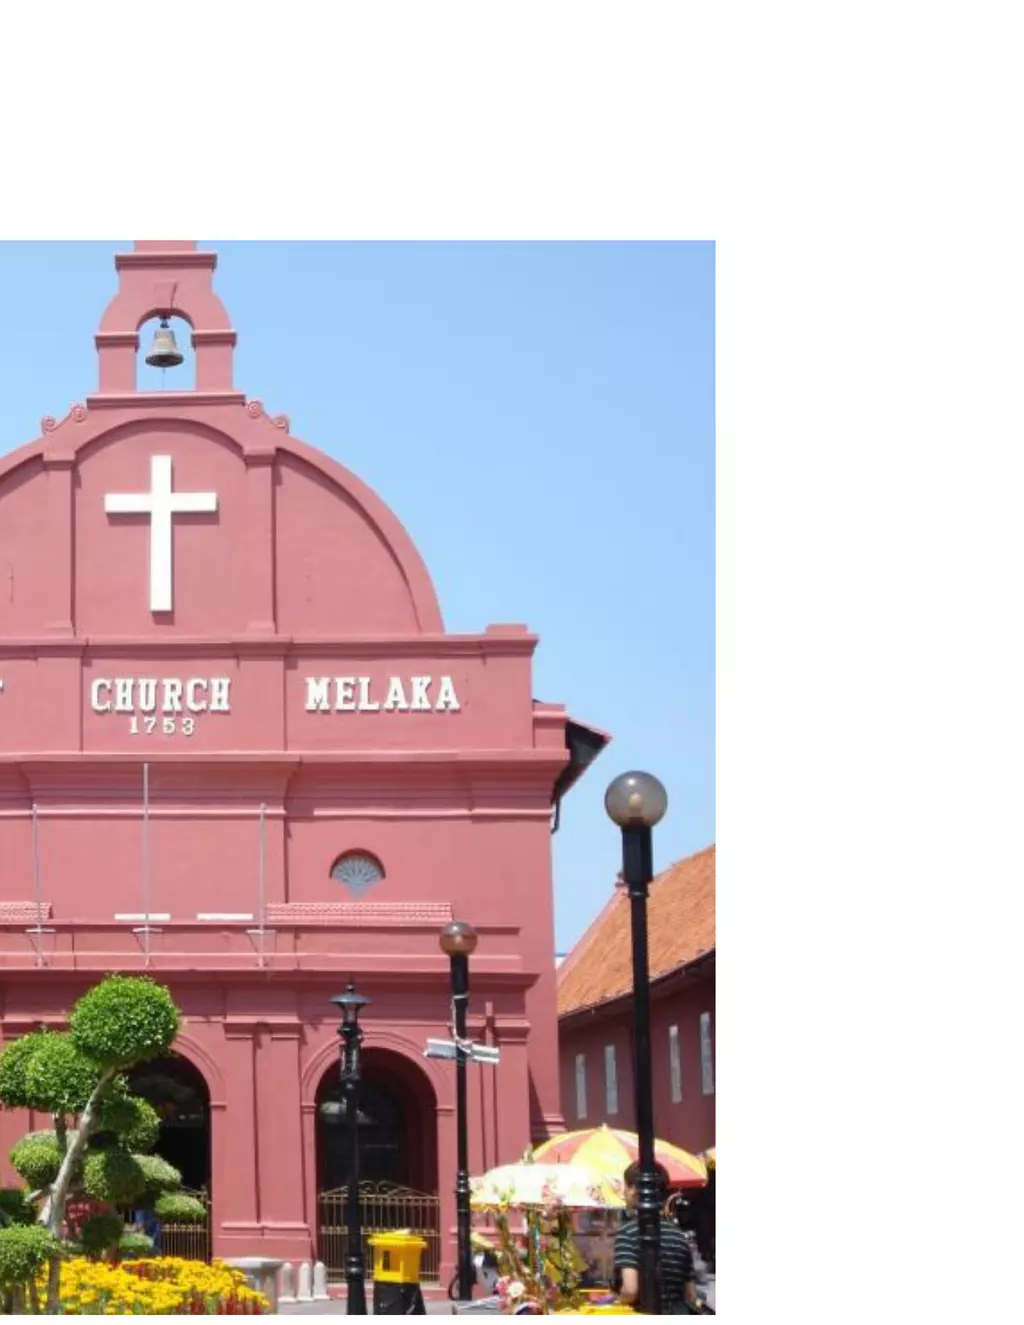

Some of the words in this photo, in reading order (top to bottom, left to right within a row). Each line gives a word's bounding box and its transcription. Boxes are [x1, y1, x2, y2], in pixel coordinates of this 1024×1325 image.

[91, 678, 231, 712] CHURCH
[304, 676, 461, 711] MELAKA
[129, 716, 195, 735] 1753
